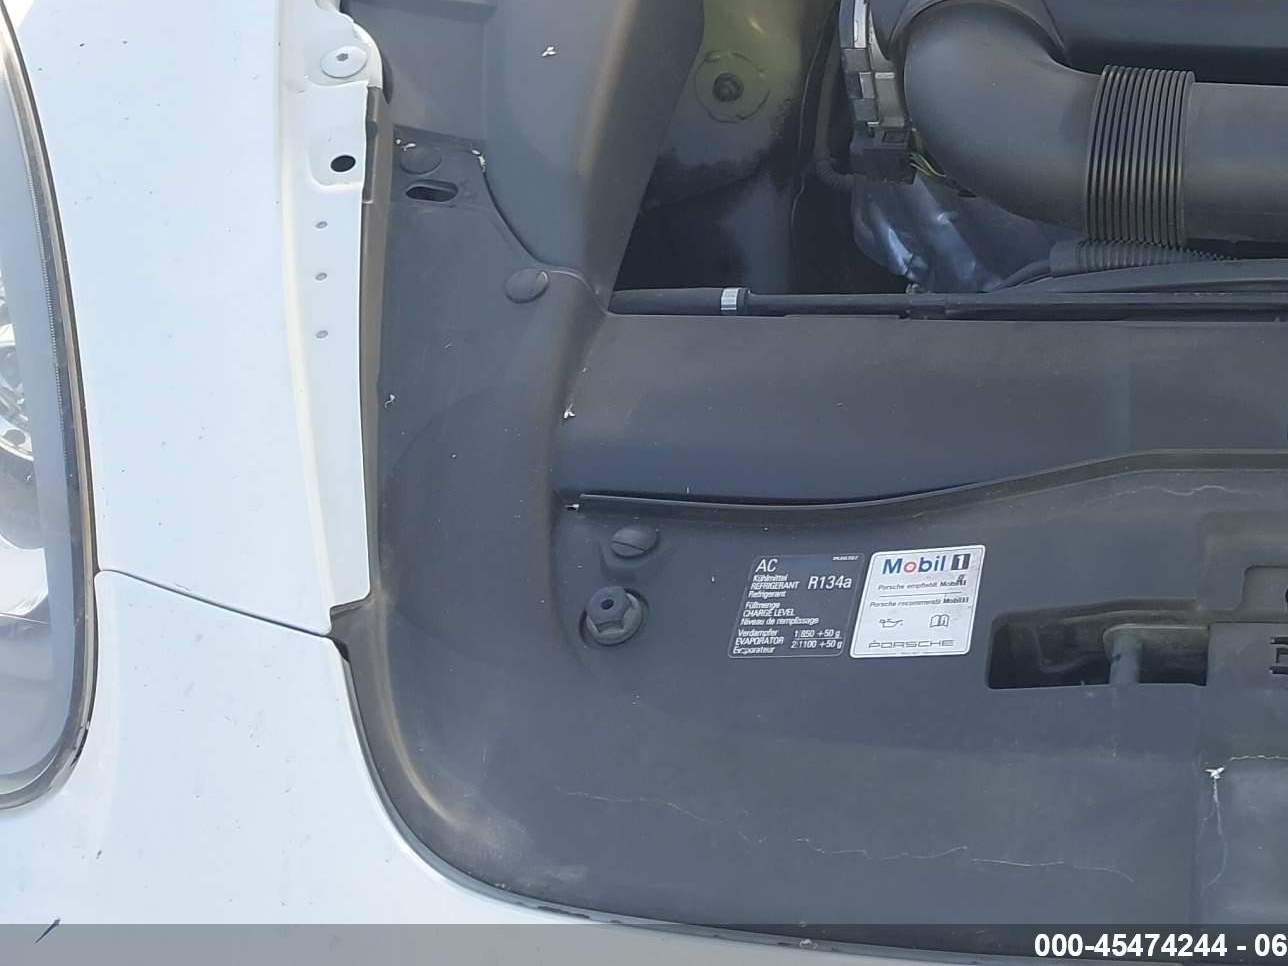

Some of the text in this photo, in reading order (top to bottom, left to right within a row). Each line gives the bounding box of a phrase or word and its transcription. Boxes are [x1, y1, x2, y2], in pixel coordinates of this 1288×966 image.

[755, 559, 778, 572] AC
[882, 553, 971, 575] Mobil 1
[750, 581, 800, 590] REFRIGERANT
[807, 575, 852, 590] R134a
[743, 608, 795, 618] CHARGE LEVEL
[766, 617, 775, 625] de
[735, 636, 784, 645] EVAPORATOR
[868, 639, 954, 648] PORSCHE
